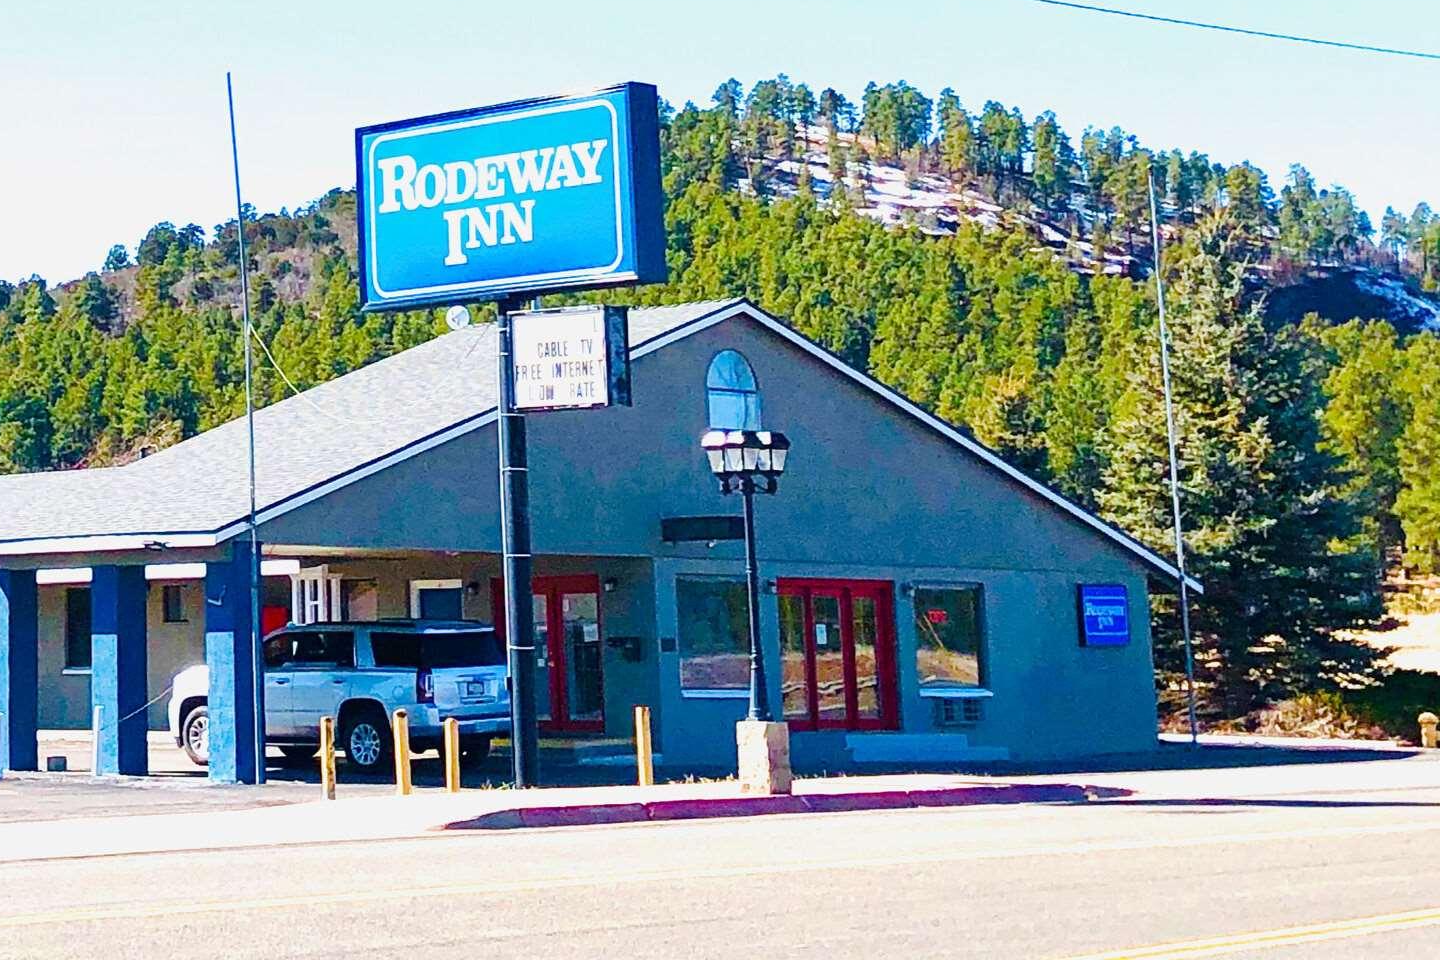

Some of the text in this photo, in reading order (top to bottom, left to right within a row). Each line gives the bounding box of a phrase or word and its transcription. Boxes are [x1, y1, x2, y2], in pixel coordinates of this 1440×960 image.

[377, 139, 608, 214] RODEWAY
[443, 200, 536, 266] INN
[515, 359, 603, 380] FREE INTERNET
[537, 339, 592, 358] CABLE TV
